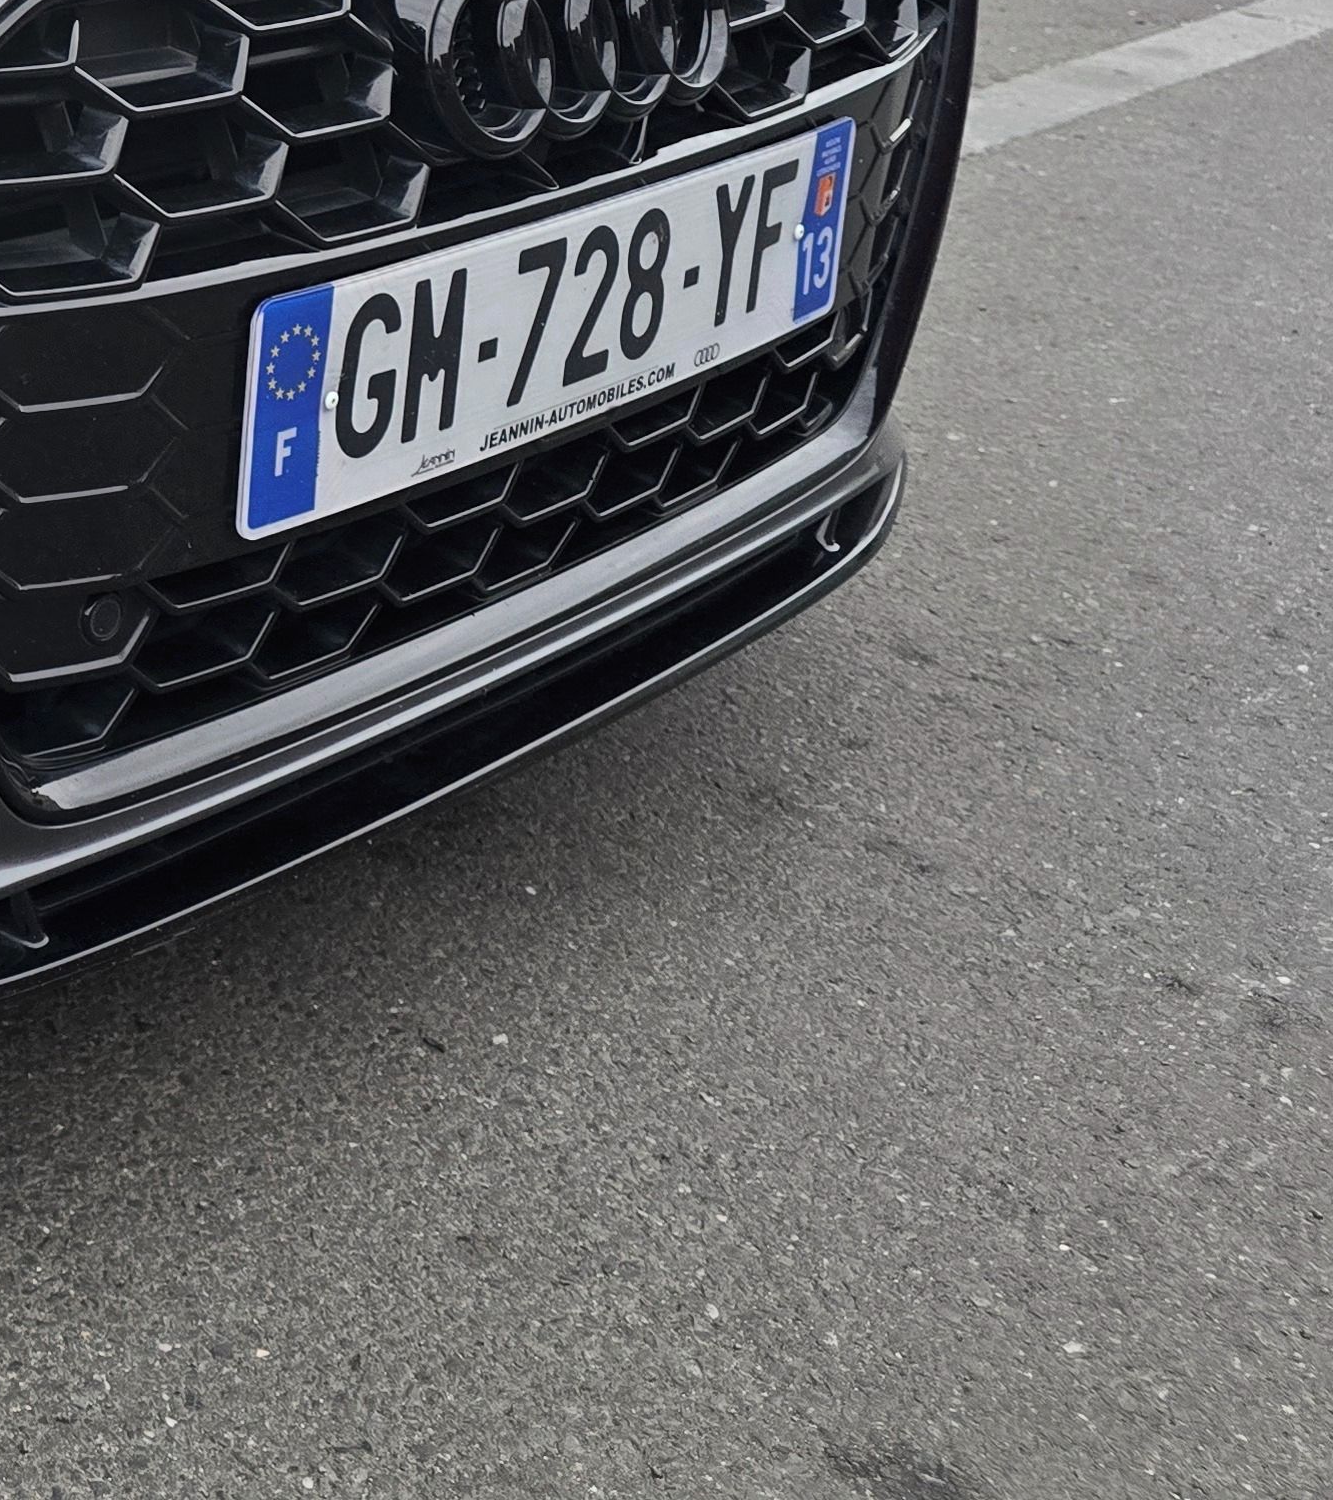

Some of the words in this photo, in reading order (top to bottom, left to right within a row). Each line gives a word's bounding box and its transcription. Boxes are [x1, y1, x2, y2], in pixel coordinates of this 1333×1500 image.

[802, 226, 833, 295] 13
[335, 159, 799, 459] GM-728-YF
[480, 362, 676, 452] JEANNIN-AUTOMOBILES.COM
[275, 426, 297, 476] F
